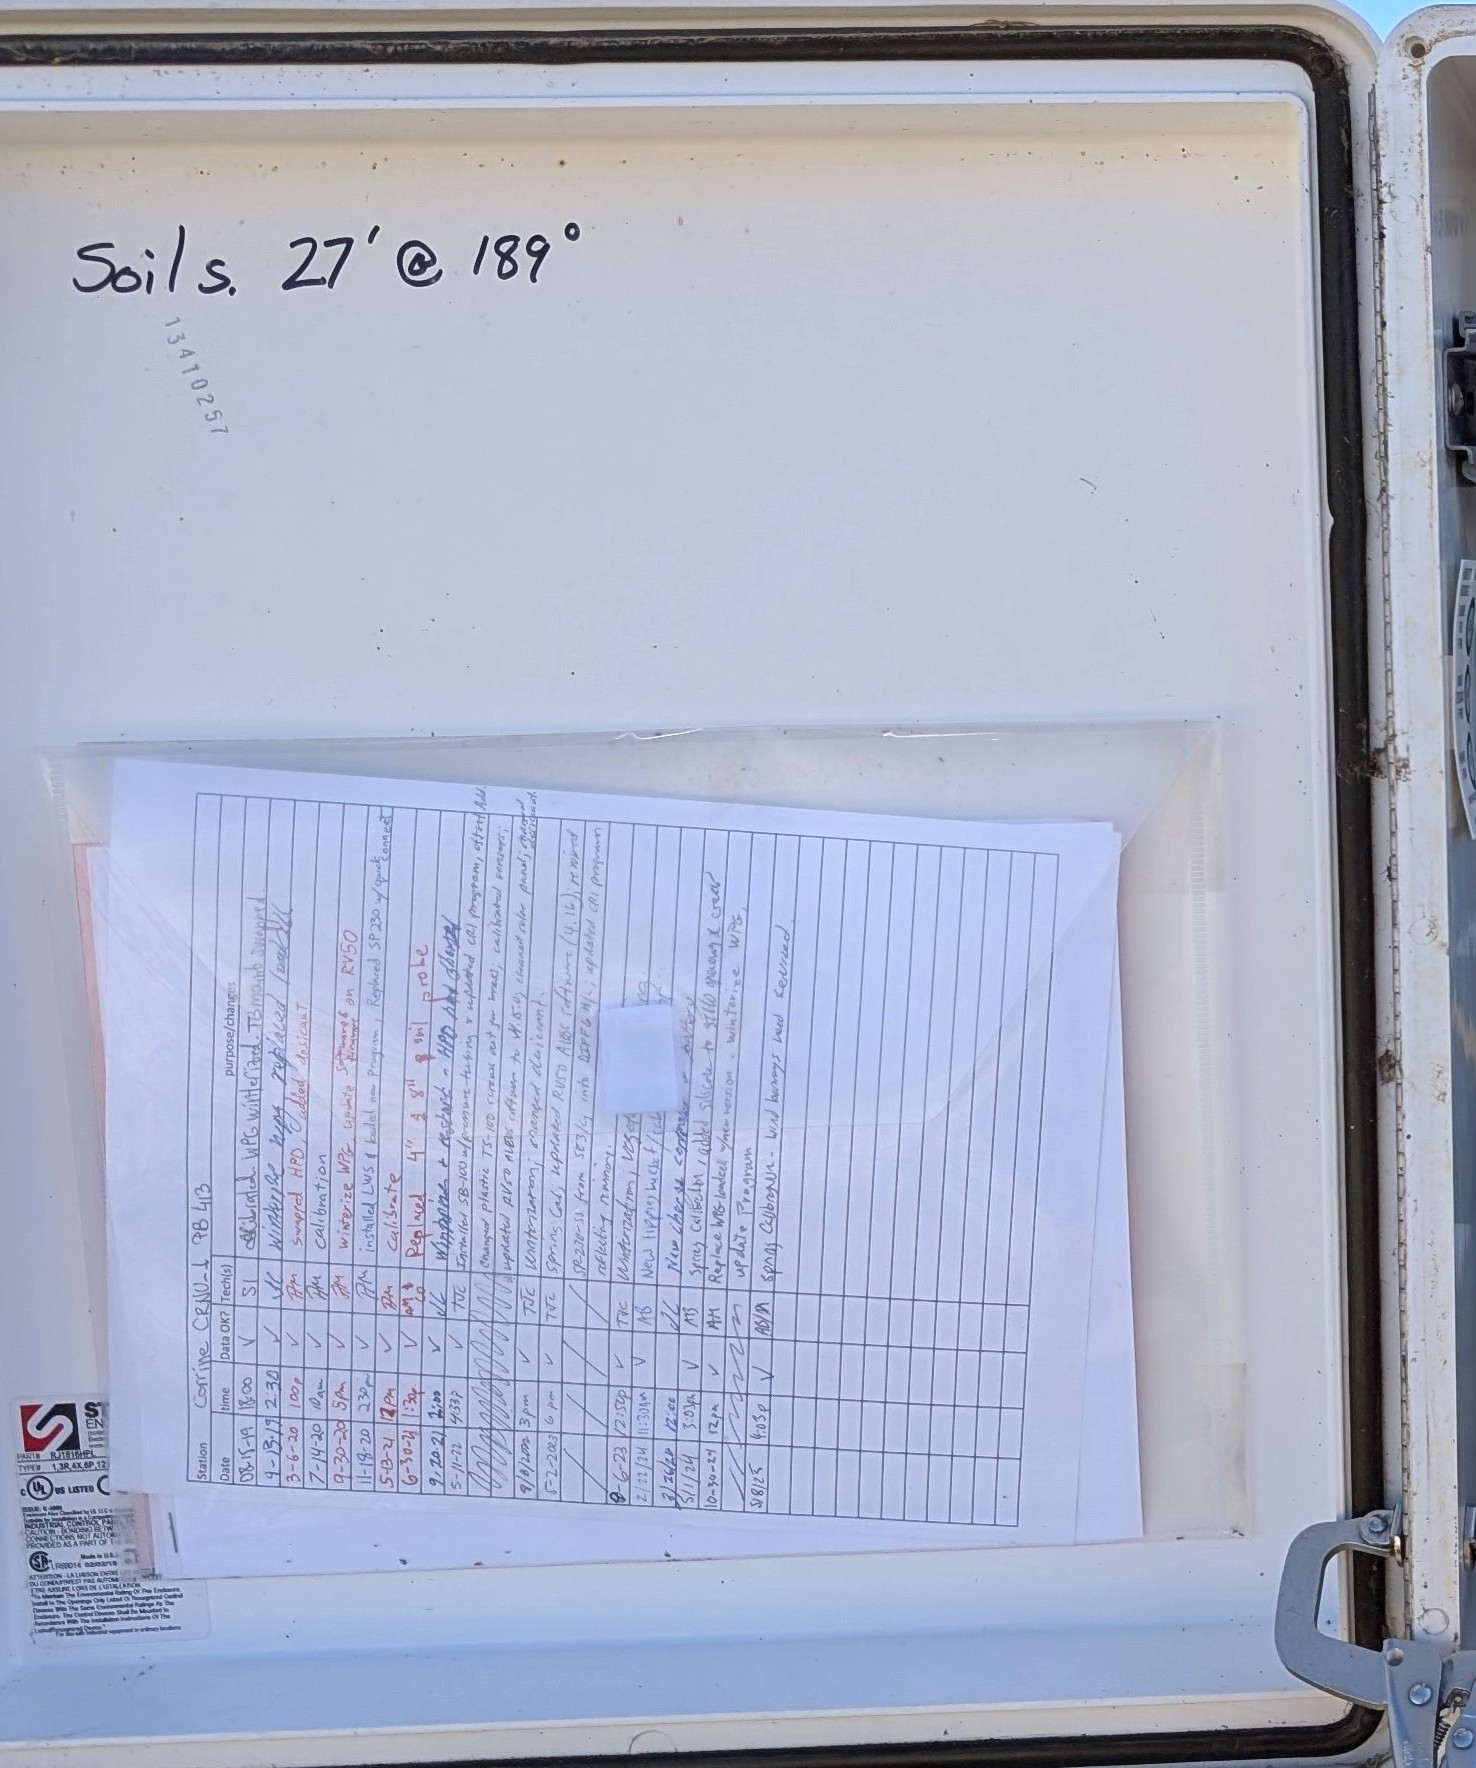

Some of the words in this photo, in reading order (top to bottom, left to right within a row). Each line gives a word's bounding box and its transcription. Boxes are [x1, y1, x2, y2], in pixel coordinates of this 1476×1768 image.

[397, 240, 443, 287] @
[224, 982, 238, 1077] purpose/changes
[191, 1183, 212, 1211] 413
[221, 1264, 233, 1302] Tech(s)
[219, 1311, 230, 1333] OK?
[220, 1336, 230, 1359] Data
[220, 1387, 230, 1410] time
[197, 1442, 207, 1480] Station
[220, 1457, 230, 1481] Date
[68, 1485, 94, 1493] LISTED
